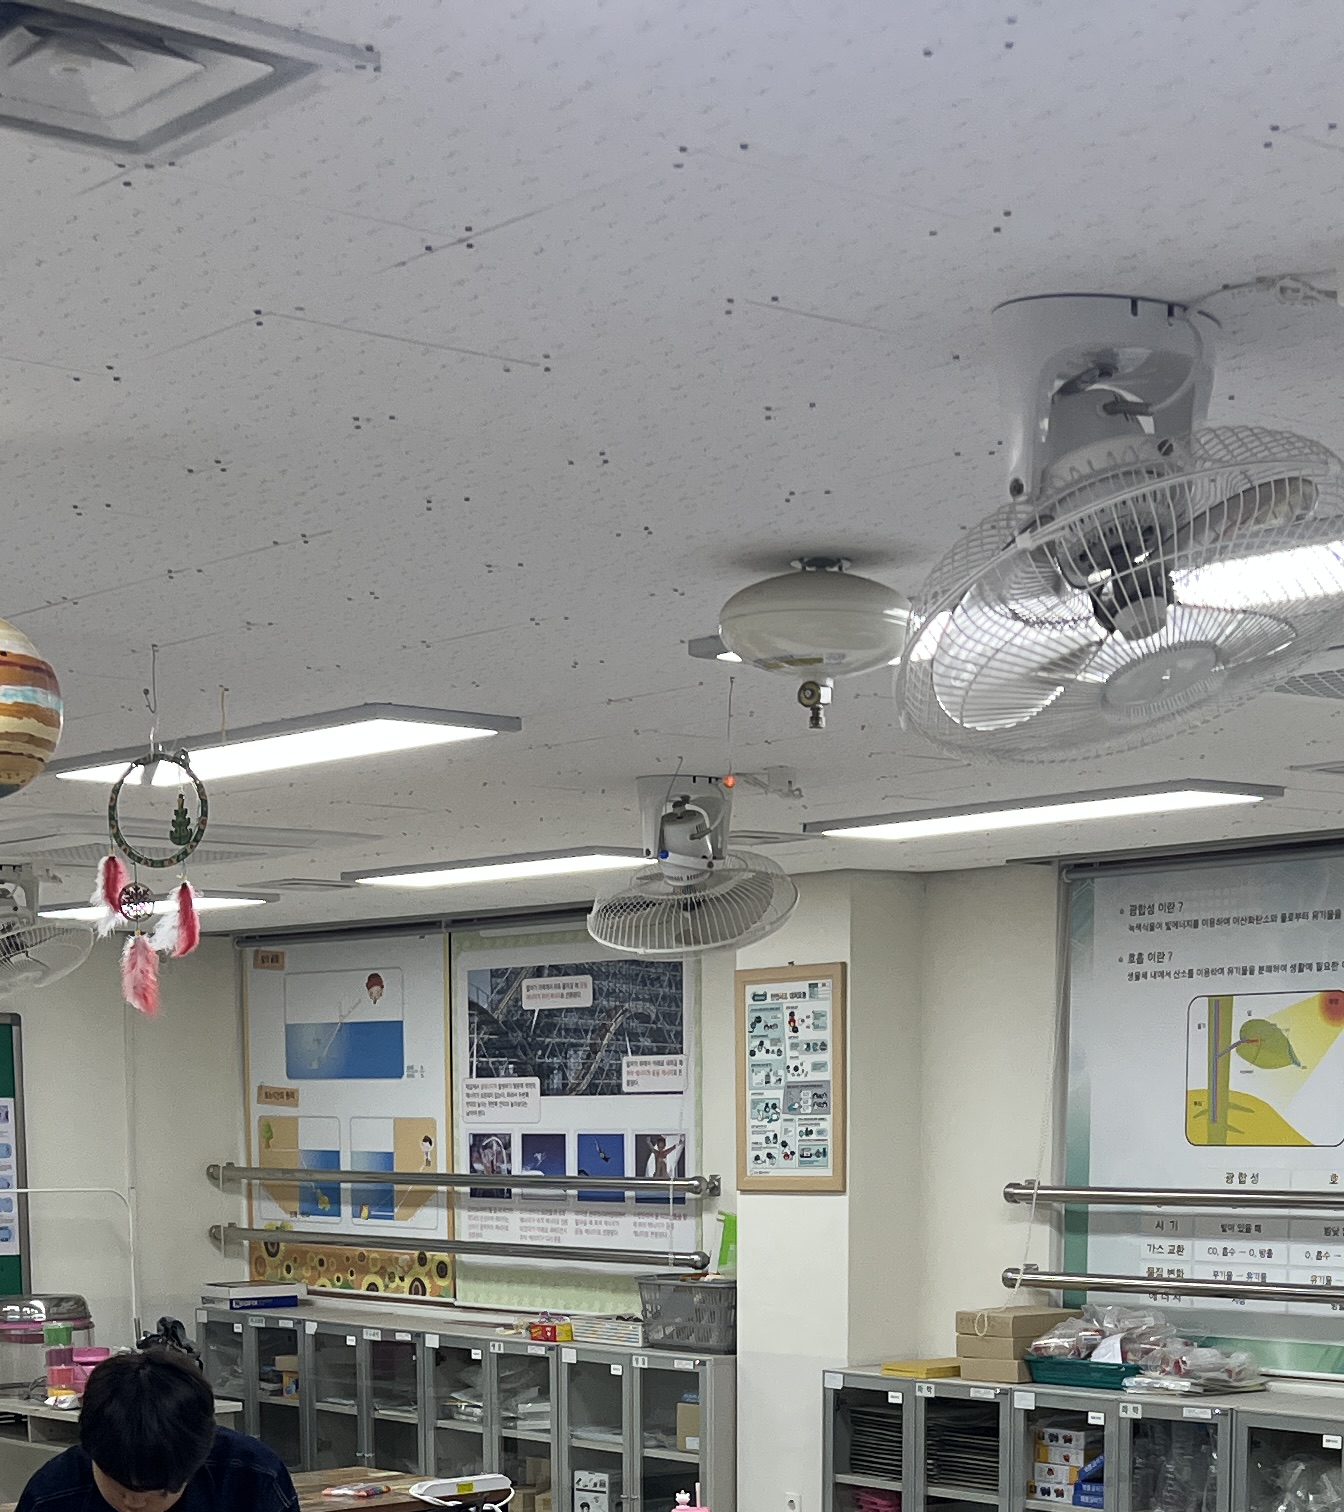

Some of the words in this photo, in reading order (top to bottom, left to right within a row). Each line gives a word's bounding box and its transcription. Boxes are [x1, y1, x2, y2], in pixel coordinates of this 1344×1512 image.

[1129, 904, 1155, 917] 광합성
[1158, 902, 1175, 914] 이란
[1127, 952, 1144, 965] 호흡
[1147, 951, 1165, 964] 이란
[1155, 1221, 1179, 1232] 시기
[1147, 1244, 1165, 1255] 가스
[1167, 1244, 1185, 1256] 교환
